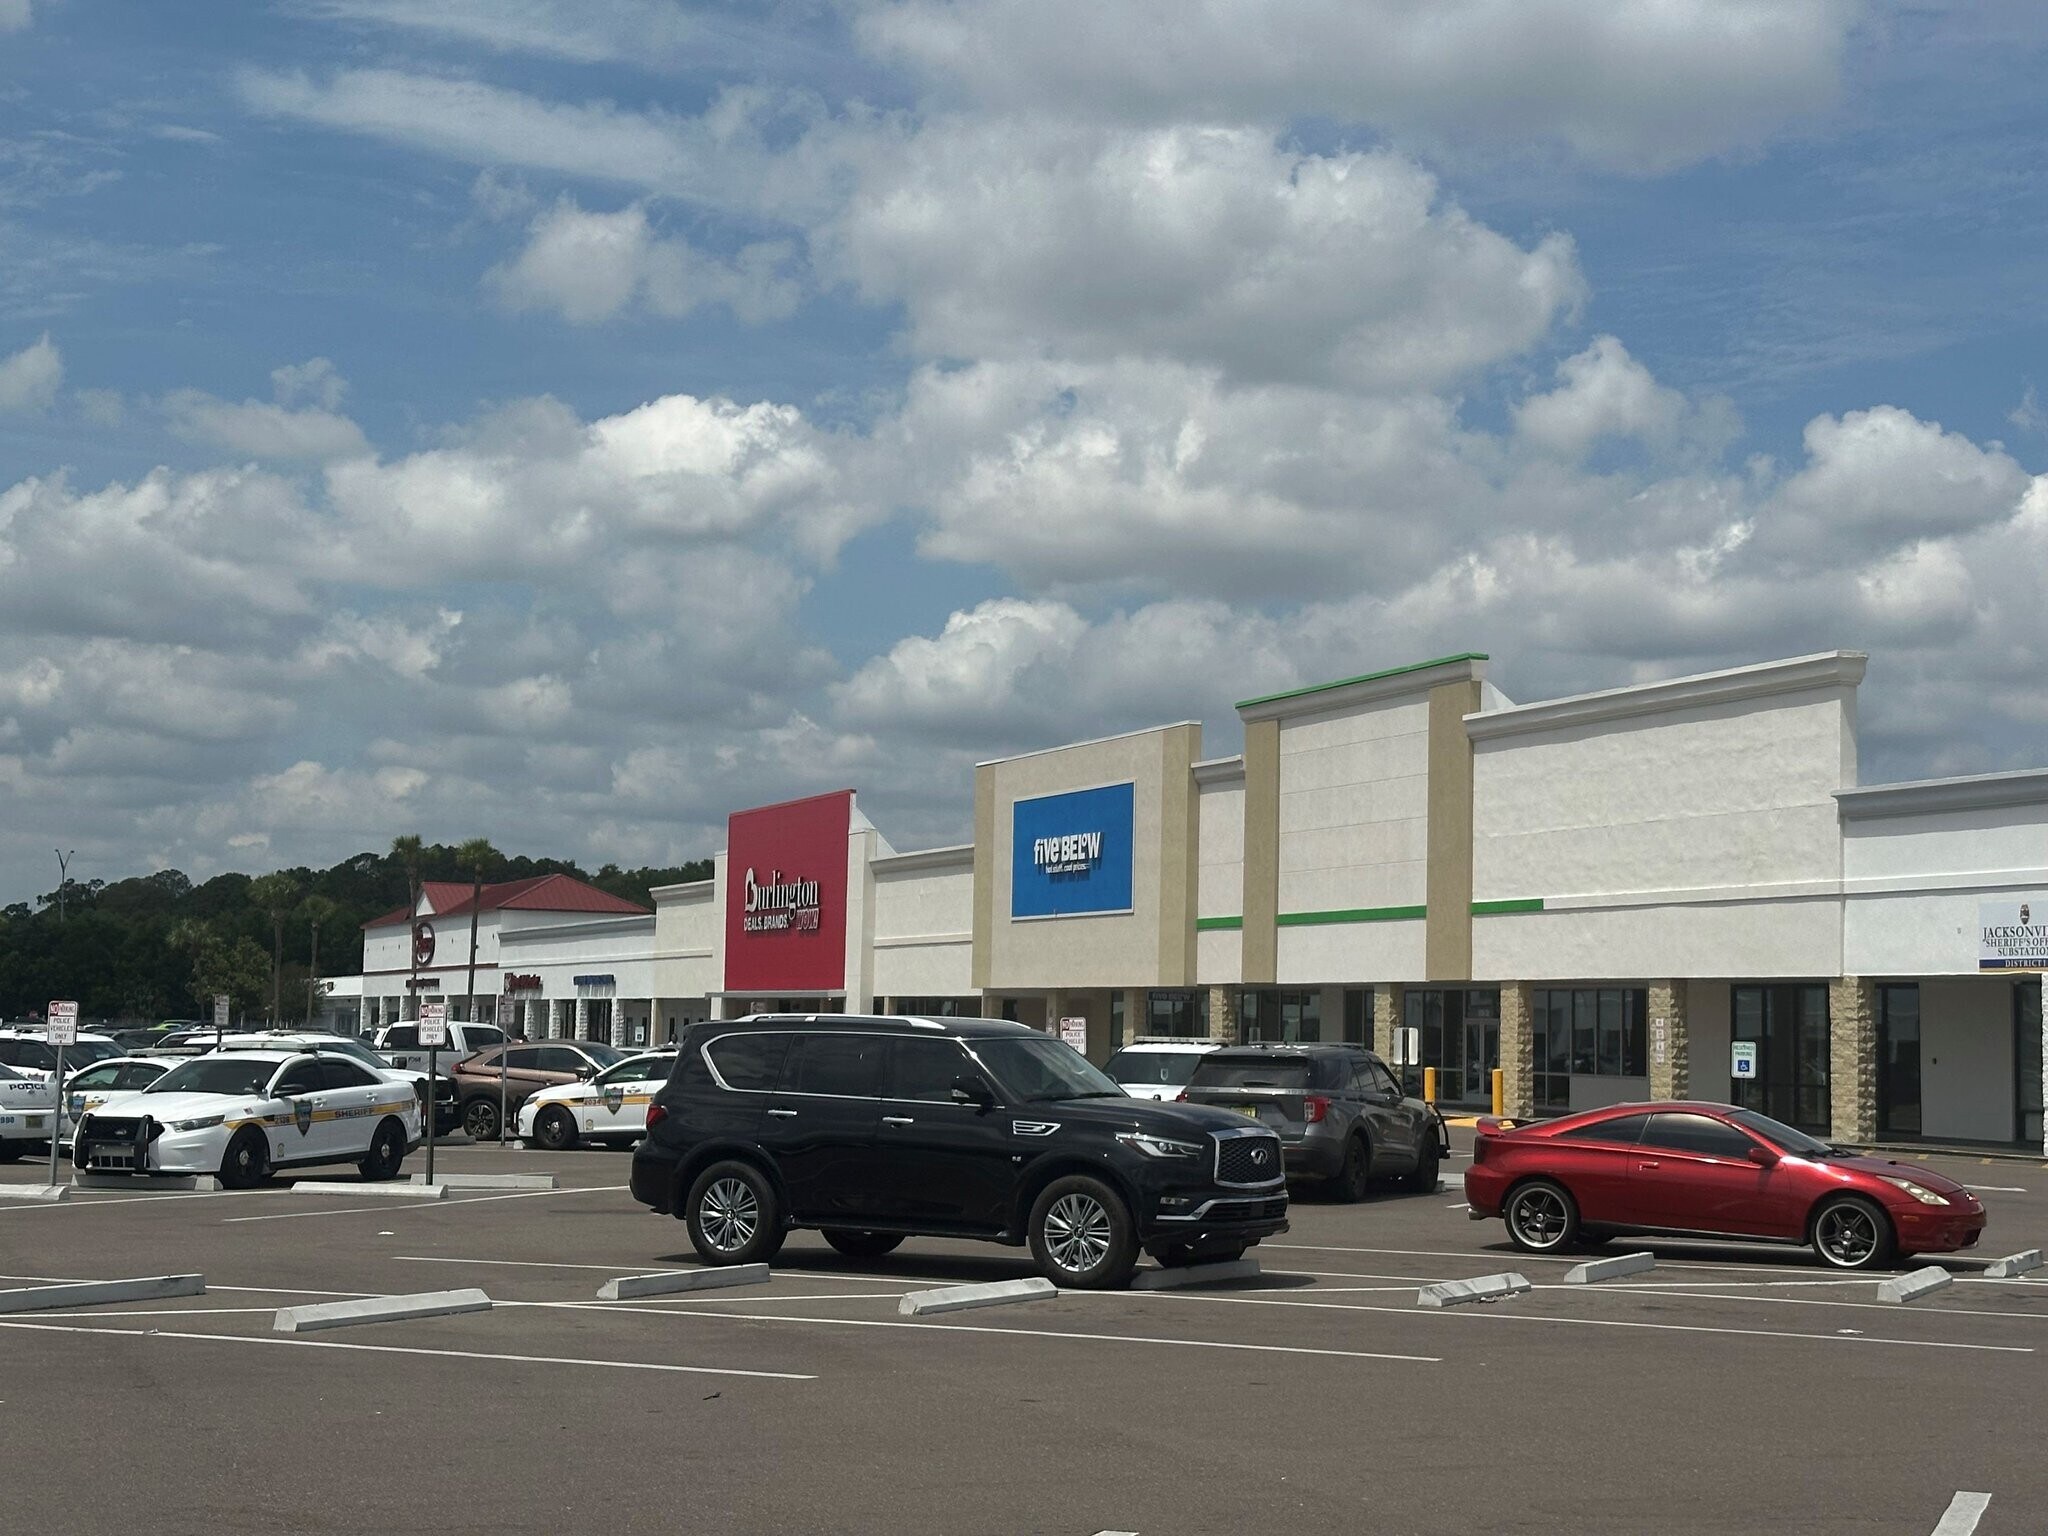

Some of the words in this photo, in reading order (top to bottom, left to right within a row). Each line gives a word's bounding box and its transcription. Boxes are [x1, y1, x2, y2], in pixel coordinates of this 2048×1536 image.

[1034, 837, 1059, 865] five
[1061, 832, 1101, 861] BELOW
[745, 868, 818, 920] Burlington
[1982, 925, 2048, 942] JACKSONVI
[334, 1108, 375, 1118] SHERIFF
